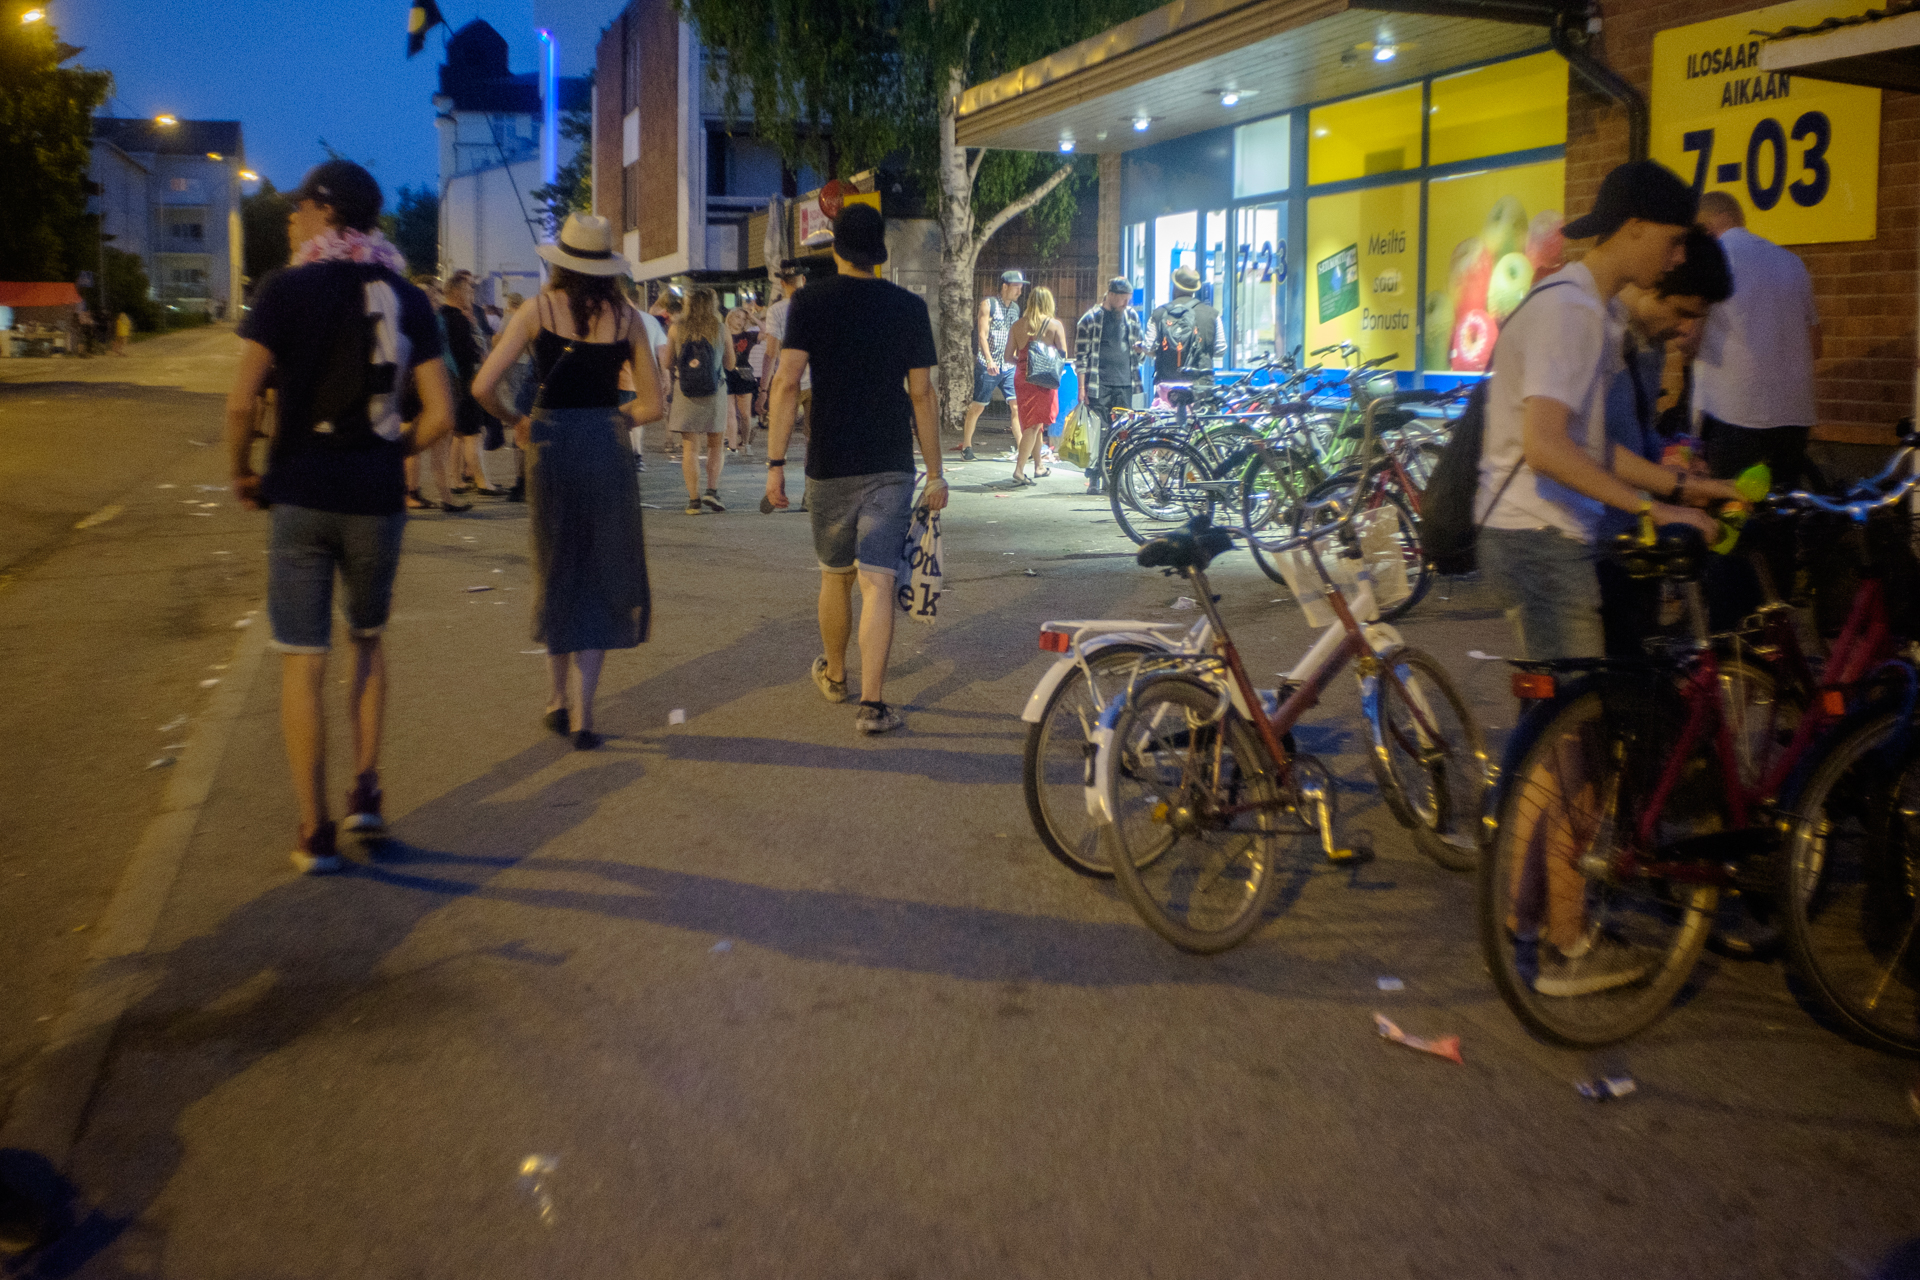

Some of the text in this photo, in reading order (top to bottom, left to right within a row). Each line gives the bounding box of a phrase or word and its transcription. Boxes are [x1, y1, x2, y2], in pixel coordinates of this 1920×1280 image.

[1686, 41, 1760, 79] ILOSAAR
[1720, 73, 1791, 108] AIKAAN
[1683, 111, 1831, 211] 7-03
[1367, 229, 1406, 256] Meiltä
[1361, 307, 1409, 330] Bonusta
